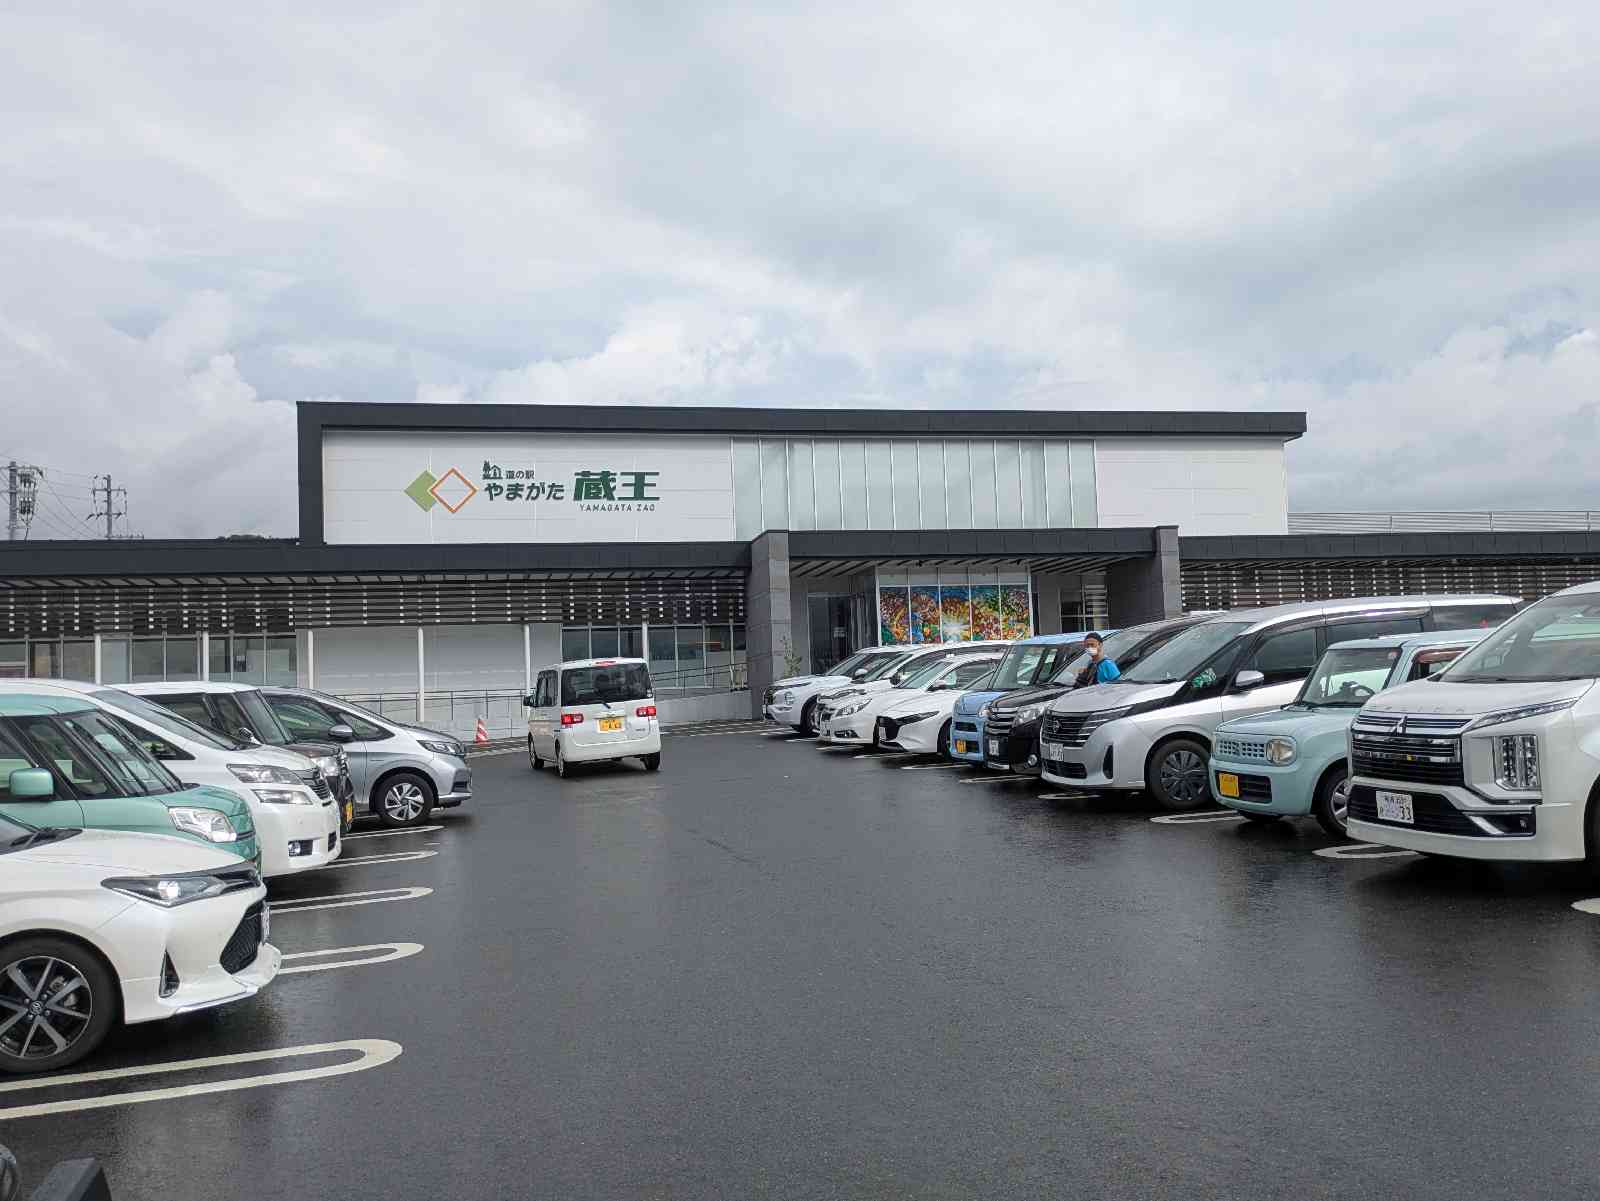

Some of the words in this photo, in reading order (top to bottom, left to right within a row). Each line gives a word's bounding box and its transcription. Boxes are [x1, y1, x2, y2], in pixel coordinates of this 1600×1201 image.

[506, 470, 535, 480] 道の駅
[484, 482, 565, 501] やまがた
[573, 470, 661, 502] 蔵王
[579, 503, 632, 512] YAMAGATA
[636, 503, 656, 512] ZAO
